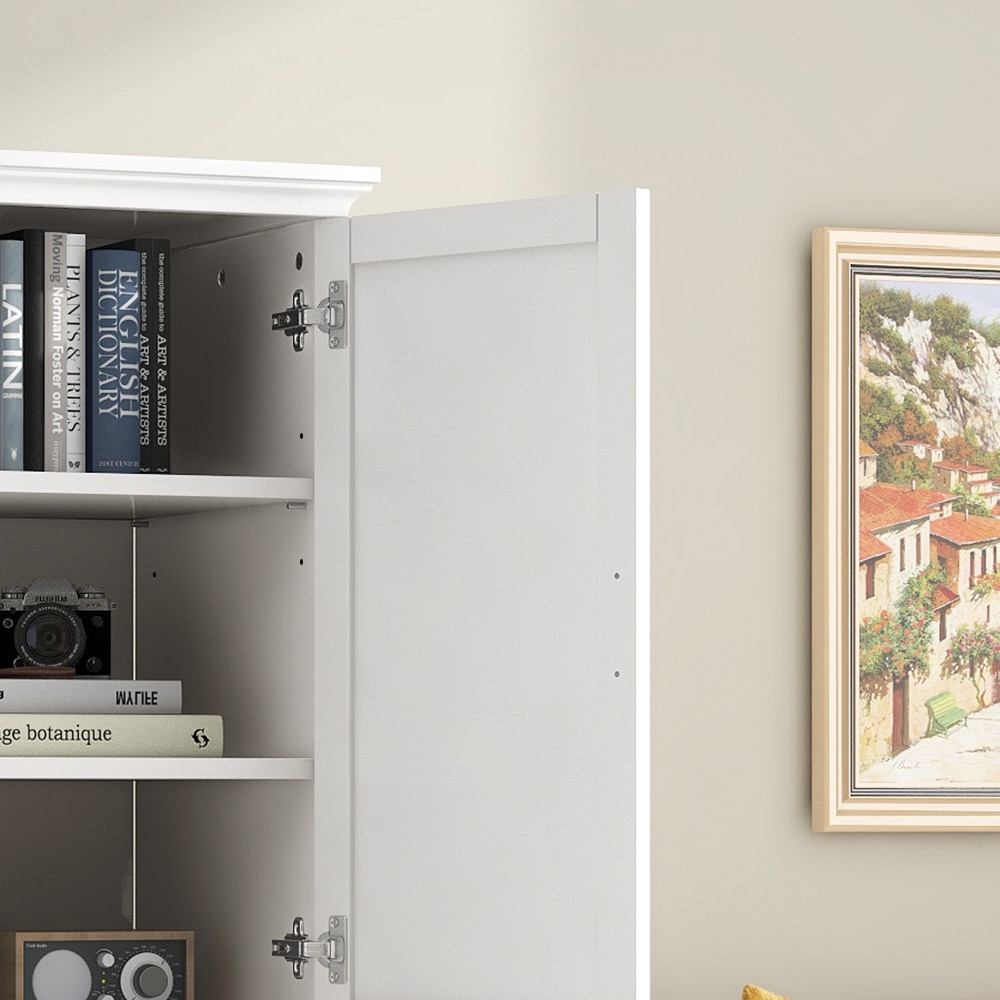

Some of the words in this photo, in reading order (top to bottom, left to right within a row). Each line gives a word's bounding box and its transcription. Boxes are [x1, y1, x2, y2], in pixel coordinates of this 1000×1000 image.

[50, 234, 63, 283] Moving
[140, 252, 148, 265] the
[158, 253, 166, 266] the
[139, 266, 148, 300] complete
[157, 266, 166, 301] complete
[52, 287, 64, 341] Norman
[66, 264, 81, 342] PLANTS
[139, 301, 148, 322] guide
[157, 301, 166, 323] guide
[2, 283, 23, 391] LATIN
[140, 322, 148, 331] to
[158, 323, 165, 332] to
[66, 346, 81, 362] &
[97, 268, 119, 420] DICTIONARY
[118, 269, 140, 420] ENGLISH
[139, 334, 150, 366] ART
[157, 334, 167, 366] ART
[52, 345, 64, 388] Foster
[139, 367, 150, 381] &
[157, 368, 167, 382] &
[52, 393, 61, 408] on
[66, 367, 81, 432] TREES
[139, 383, 150, 446] ARTISTS
[157, 384, 167, 446] ARTISTS
[52, 412, 64, 434] Art
[27, 723, 112, 745] botanique
